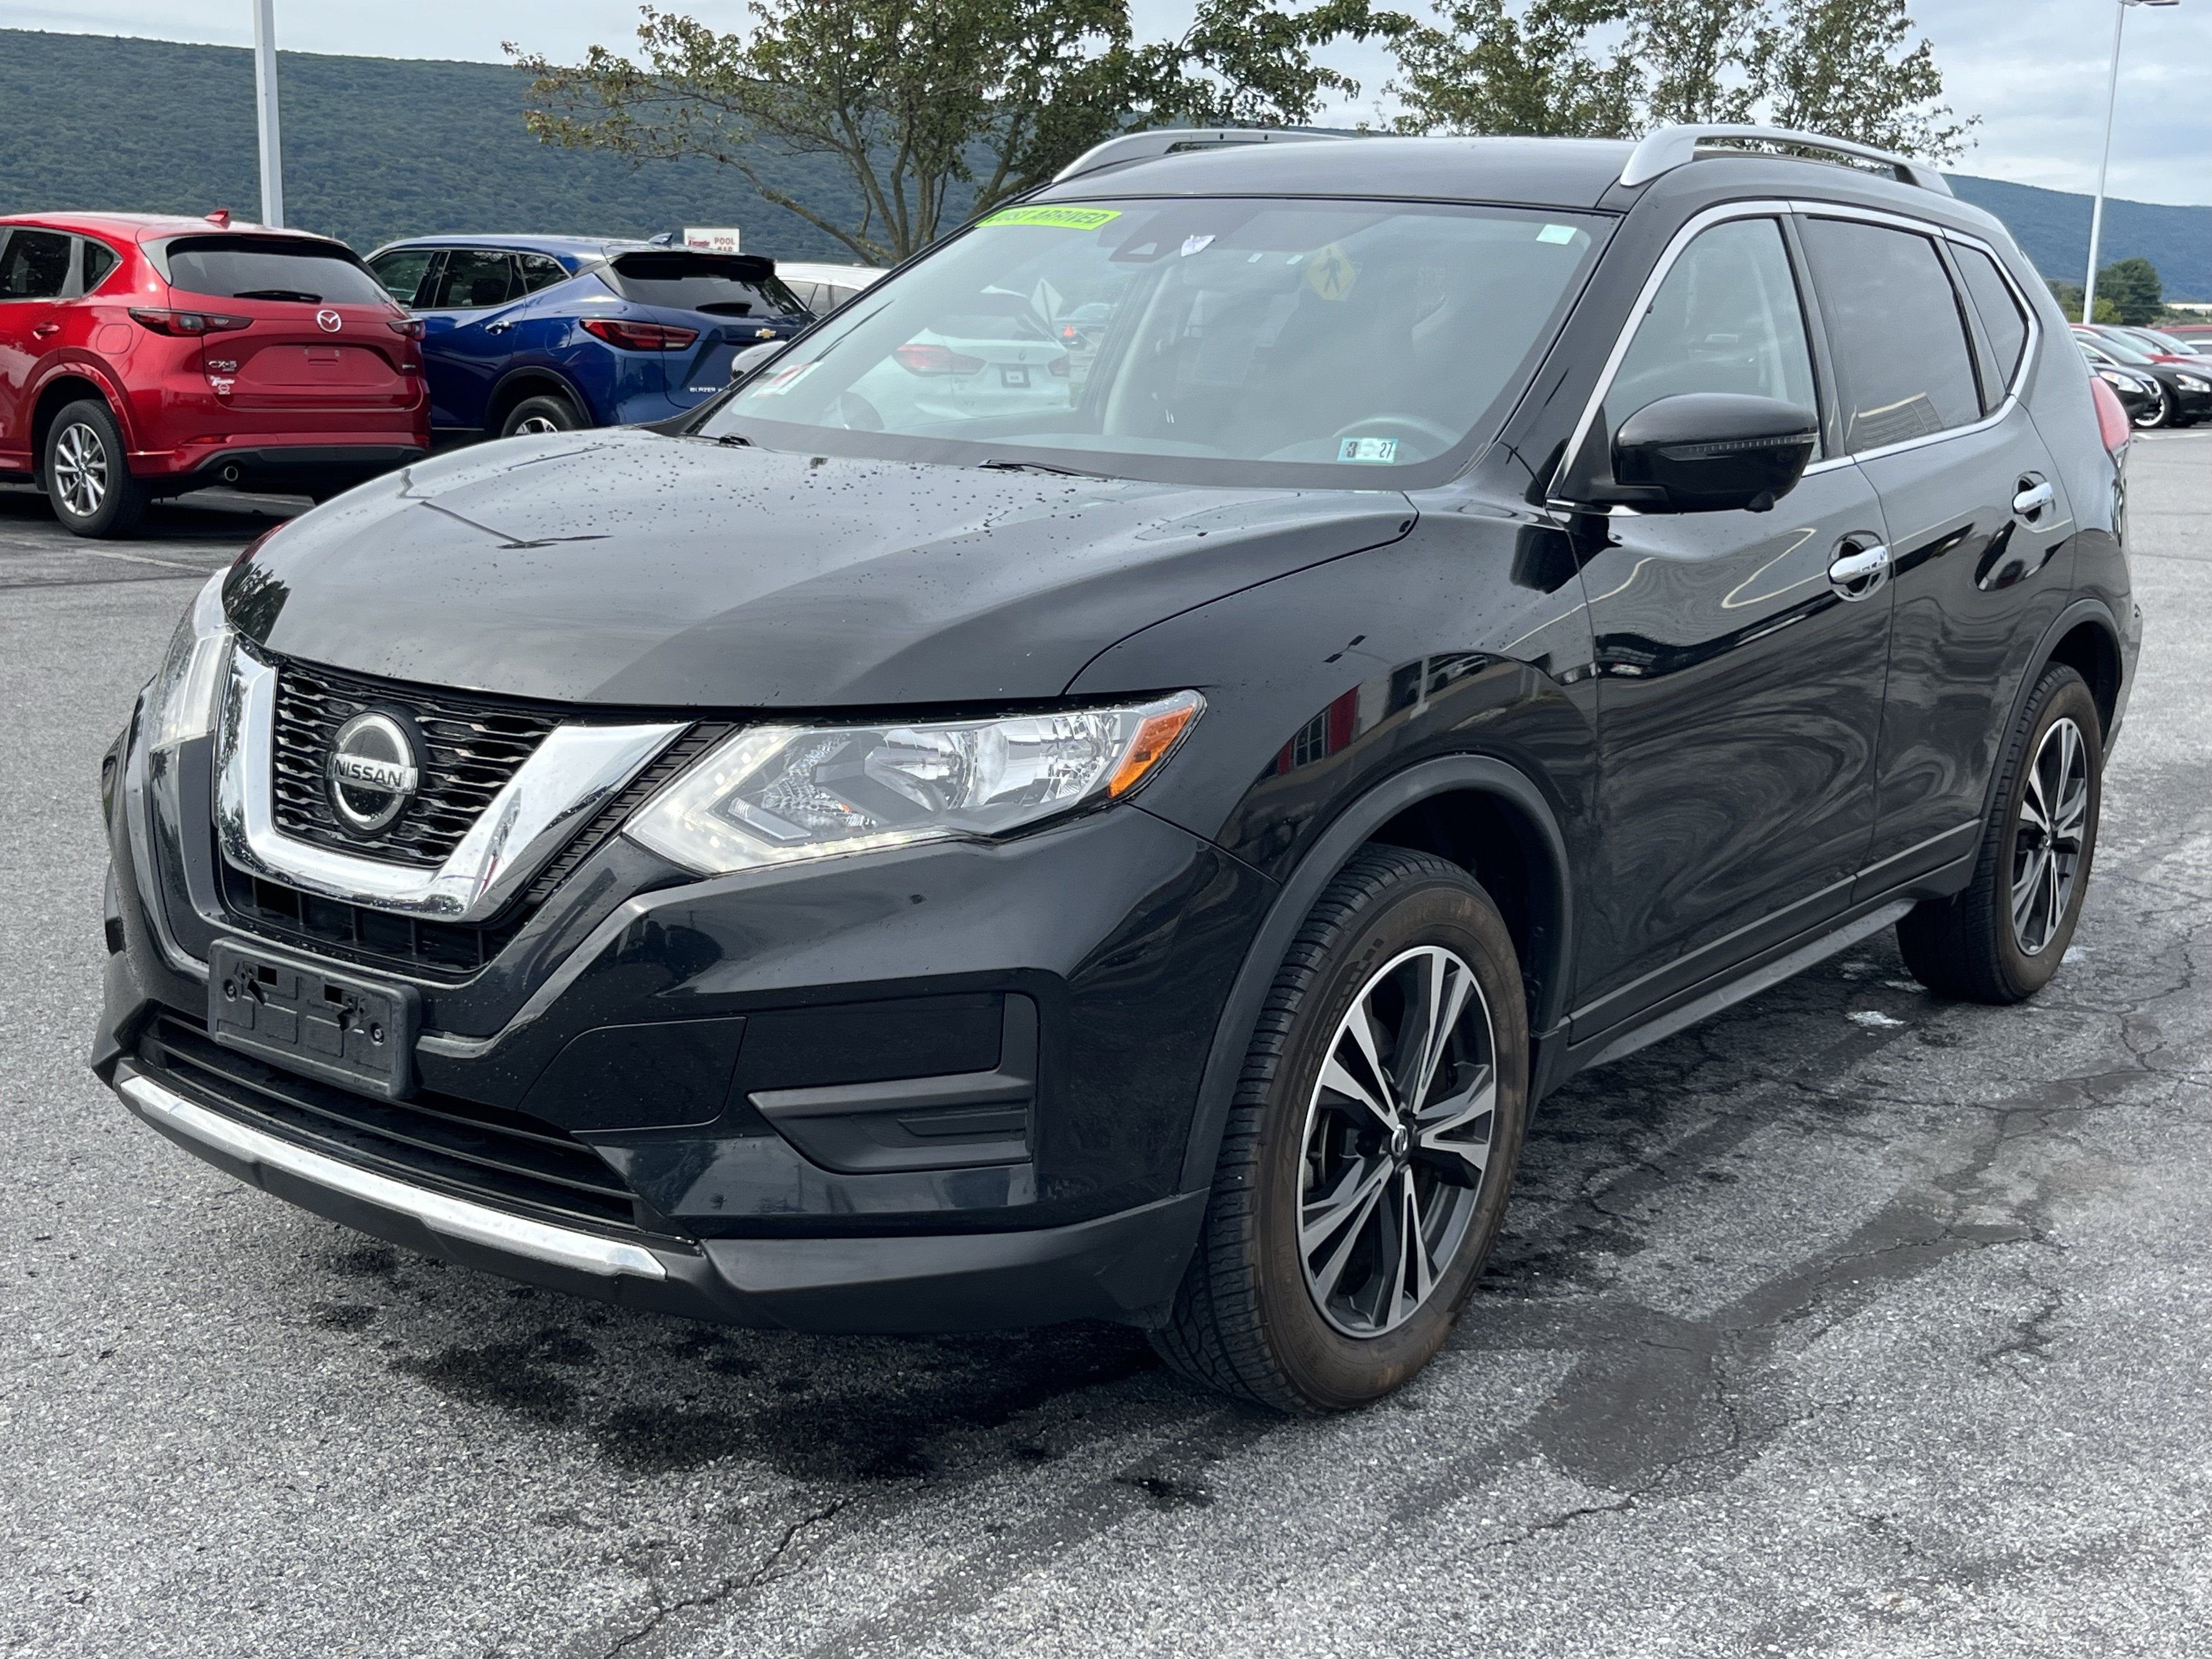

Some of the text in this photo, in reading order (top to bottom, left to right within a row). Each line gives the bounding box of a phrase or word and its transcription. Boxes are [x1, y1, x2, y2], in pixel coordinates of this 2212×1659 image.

[1025, 210, 1110, 224] ARRIVED
[715, 237, 735, 245] POOL
[1346, 441, 1393, 459] 3 27
[335, 759, 402, 787] NISSAN
